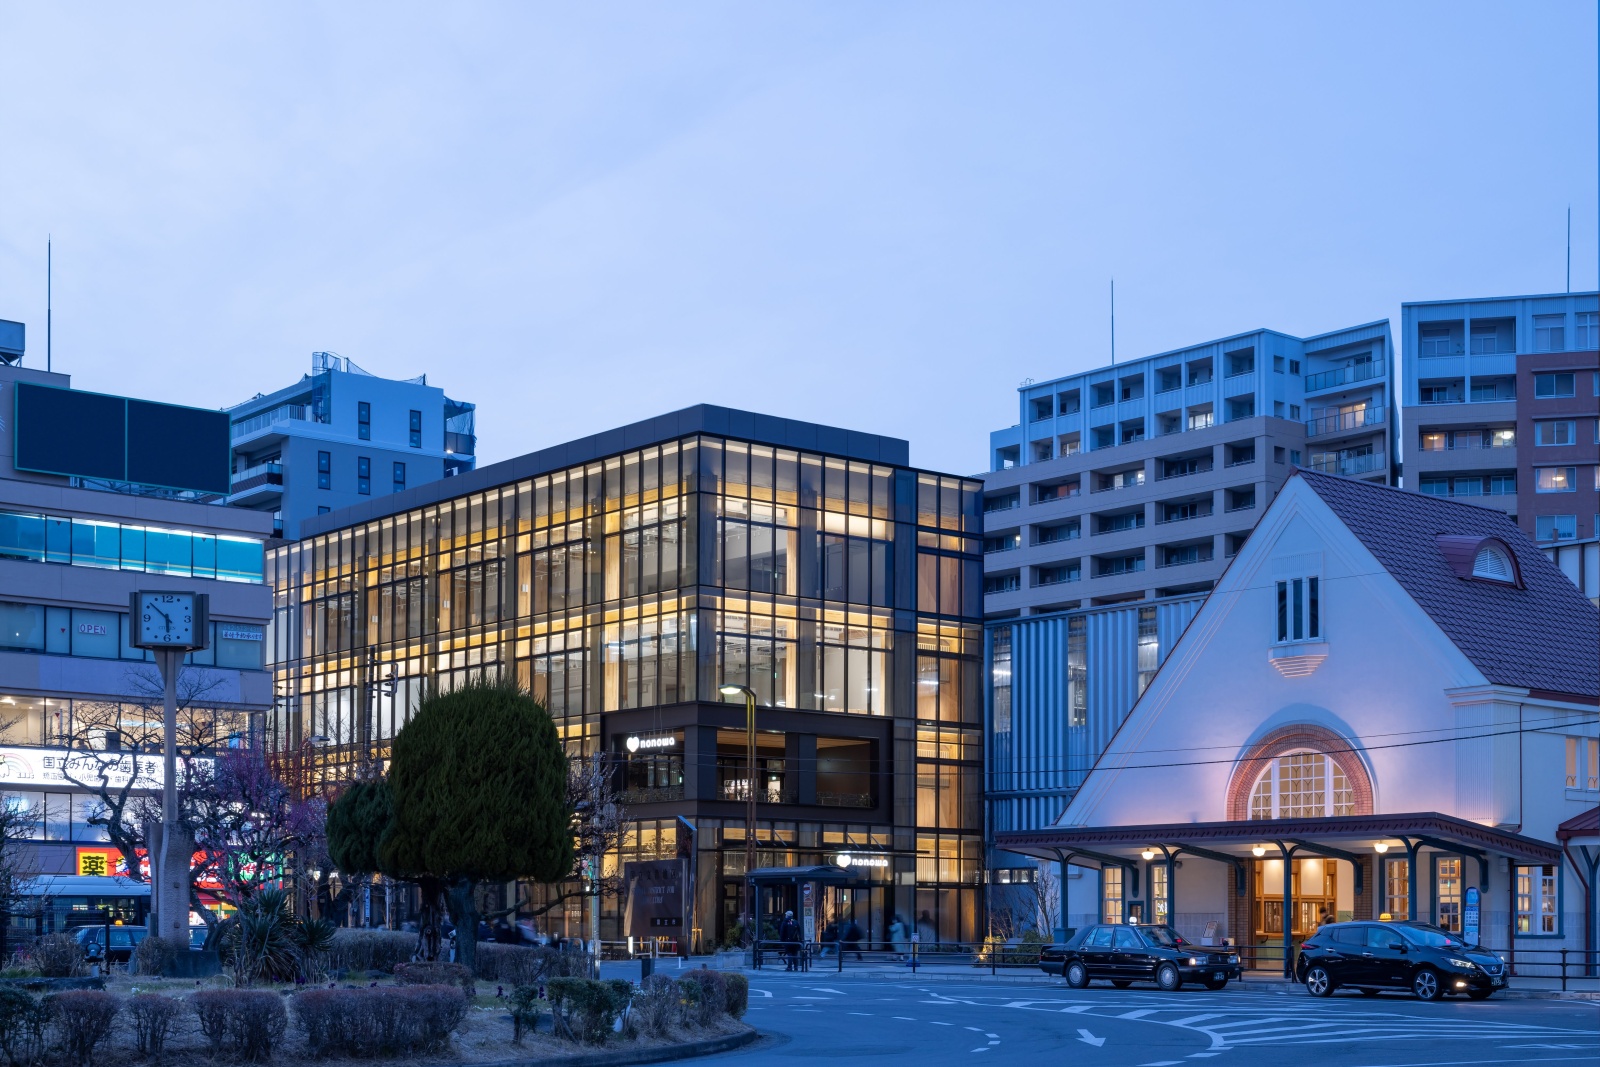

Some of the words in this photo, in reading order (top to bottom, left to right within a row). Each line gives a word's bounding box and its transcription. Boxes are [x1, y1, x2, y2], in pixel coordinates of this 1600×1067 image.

[161, 595, 174, 603] 12
[143, 614, 151, 622] 9
[184, 615, 191, 623] 3
[80, 624, 106, 634] OPEN
[163, 634, 171, 642] 6
[640, 737, 675, 748] nonowa
[82, 856, 105, 876] 薬
[852, 858, 888, 867] nonowa
